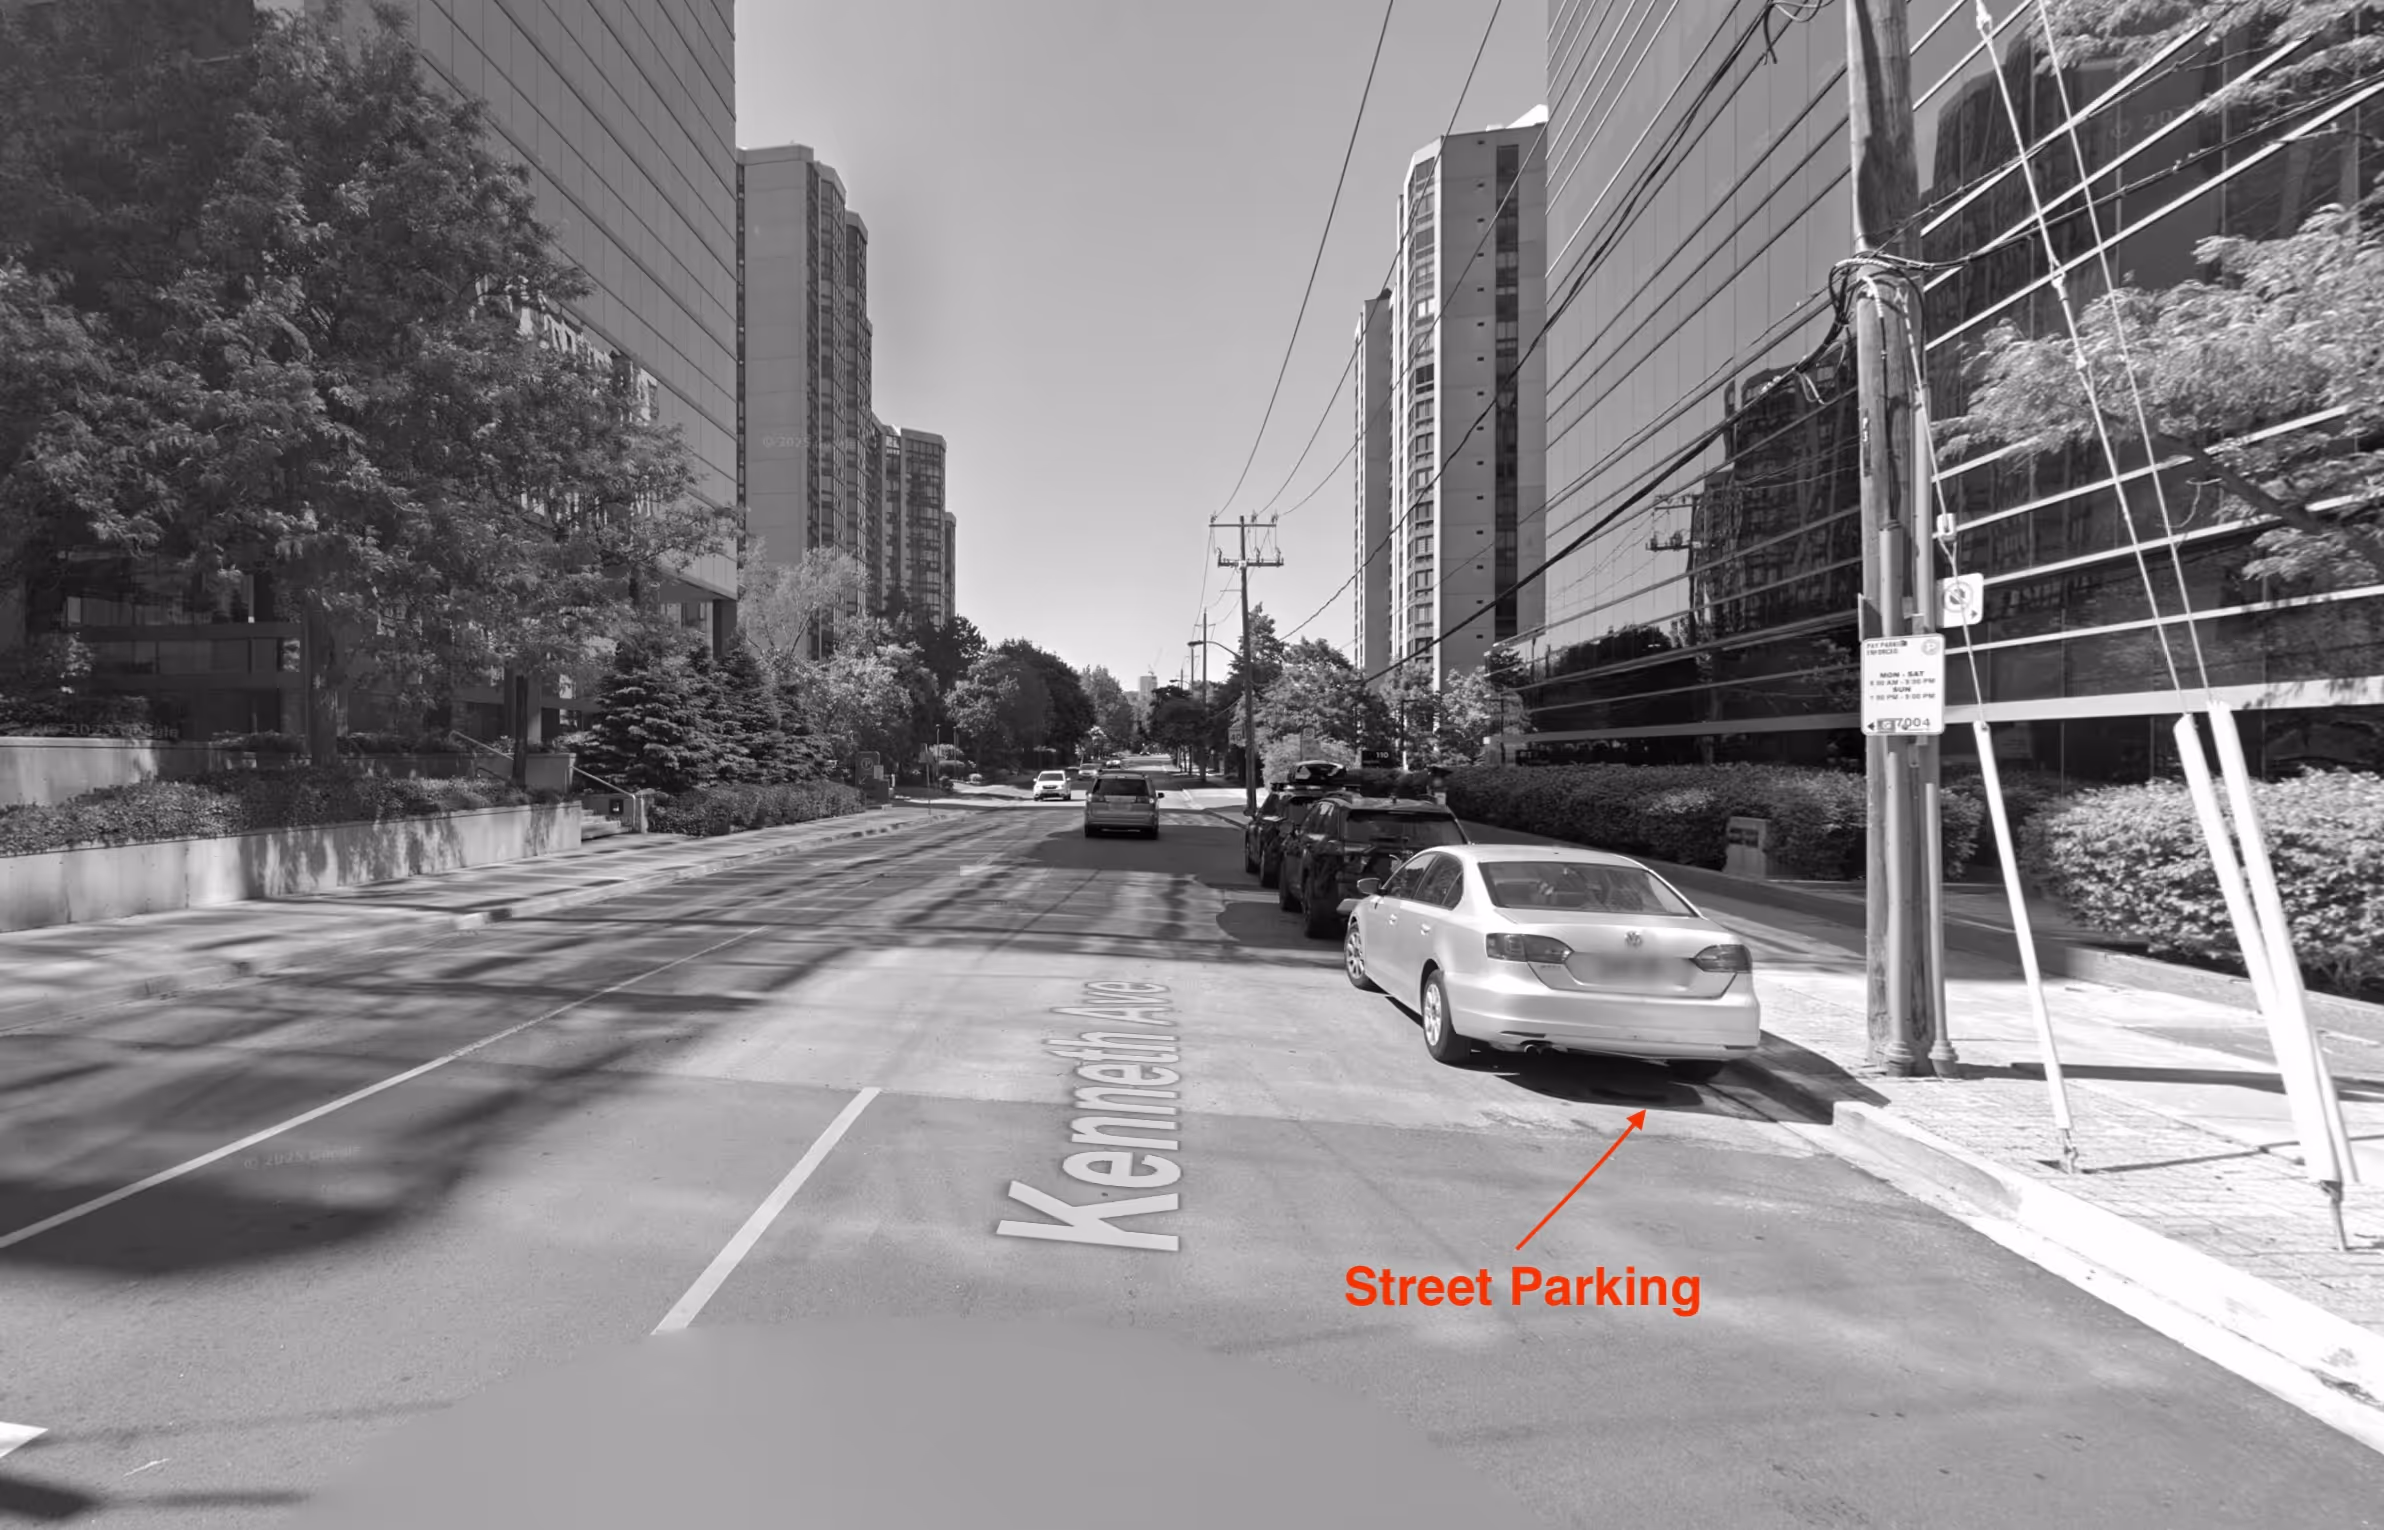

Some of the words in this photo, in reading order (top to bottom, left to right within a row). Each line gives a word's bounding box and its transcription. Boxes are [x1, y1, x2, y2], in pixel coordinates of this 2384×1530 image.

[1880, 640, 1907, 648] PARK
[1897, 717, 1931, 728] 7004
[1376, 751, 1389, 759] 110
